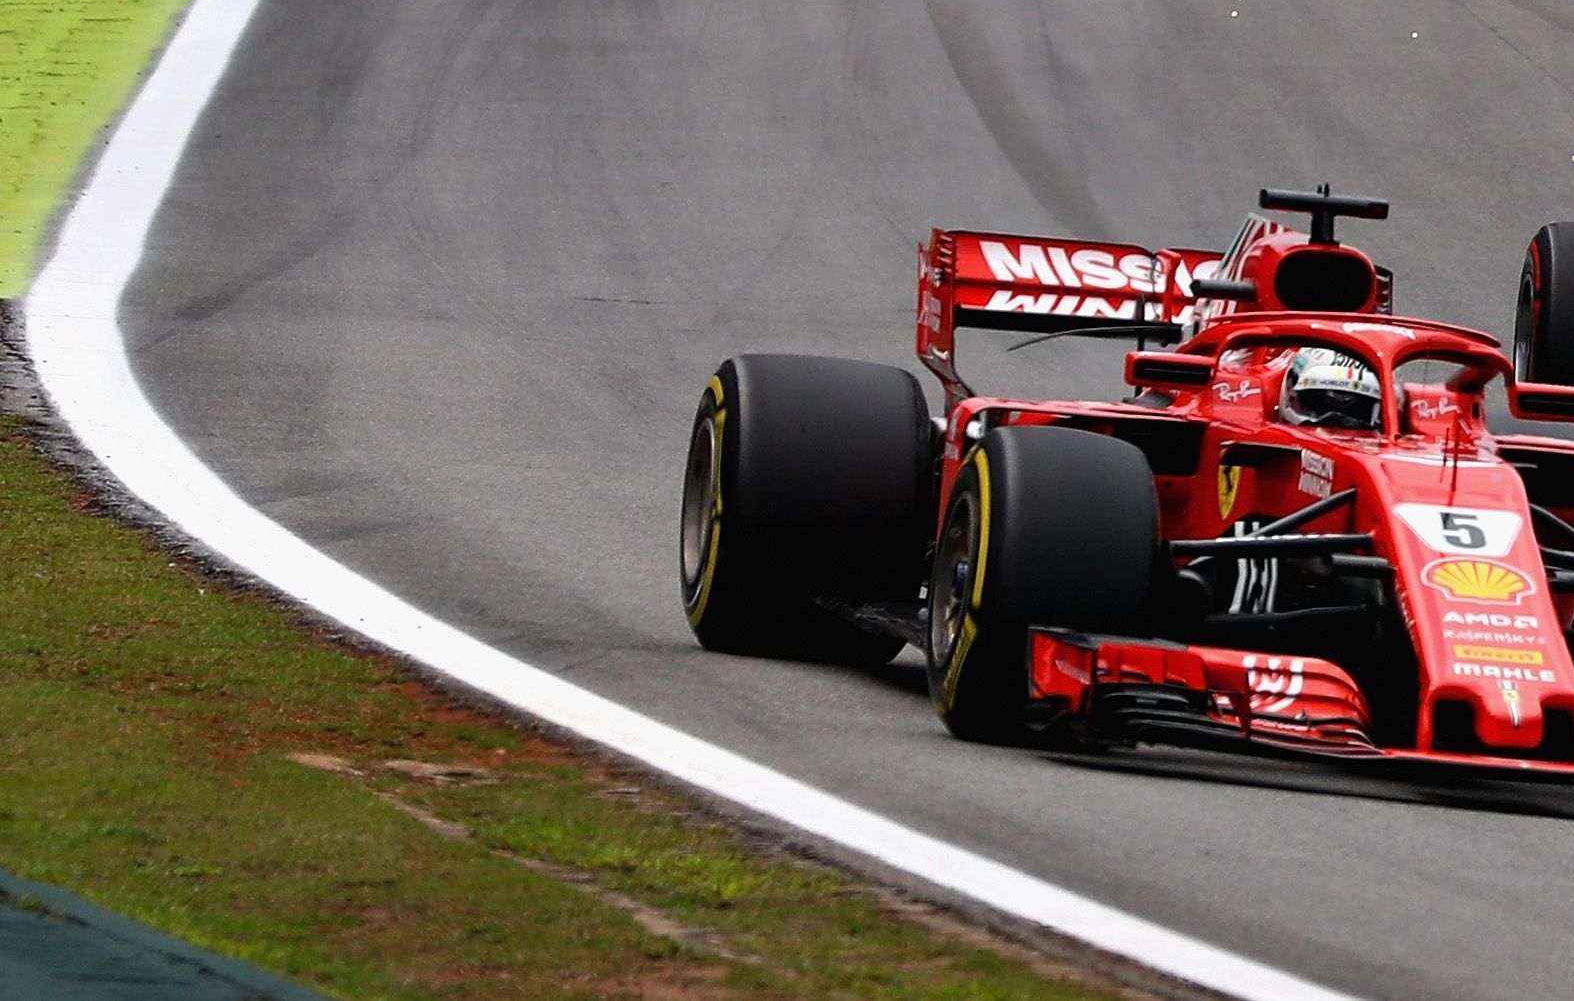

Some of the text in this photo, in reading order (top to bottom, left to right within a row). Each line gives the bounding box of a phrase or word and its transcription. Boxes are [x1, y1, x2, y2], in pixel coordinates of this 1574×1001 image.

[1440, 511, 1486, 549] 5
[1443, 611, 1515, 627] AMD
[1452, 662, 1556, 682] MAHLE
